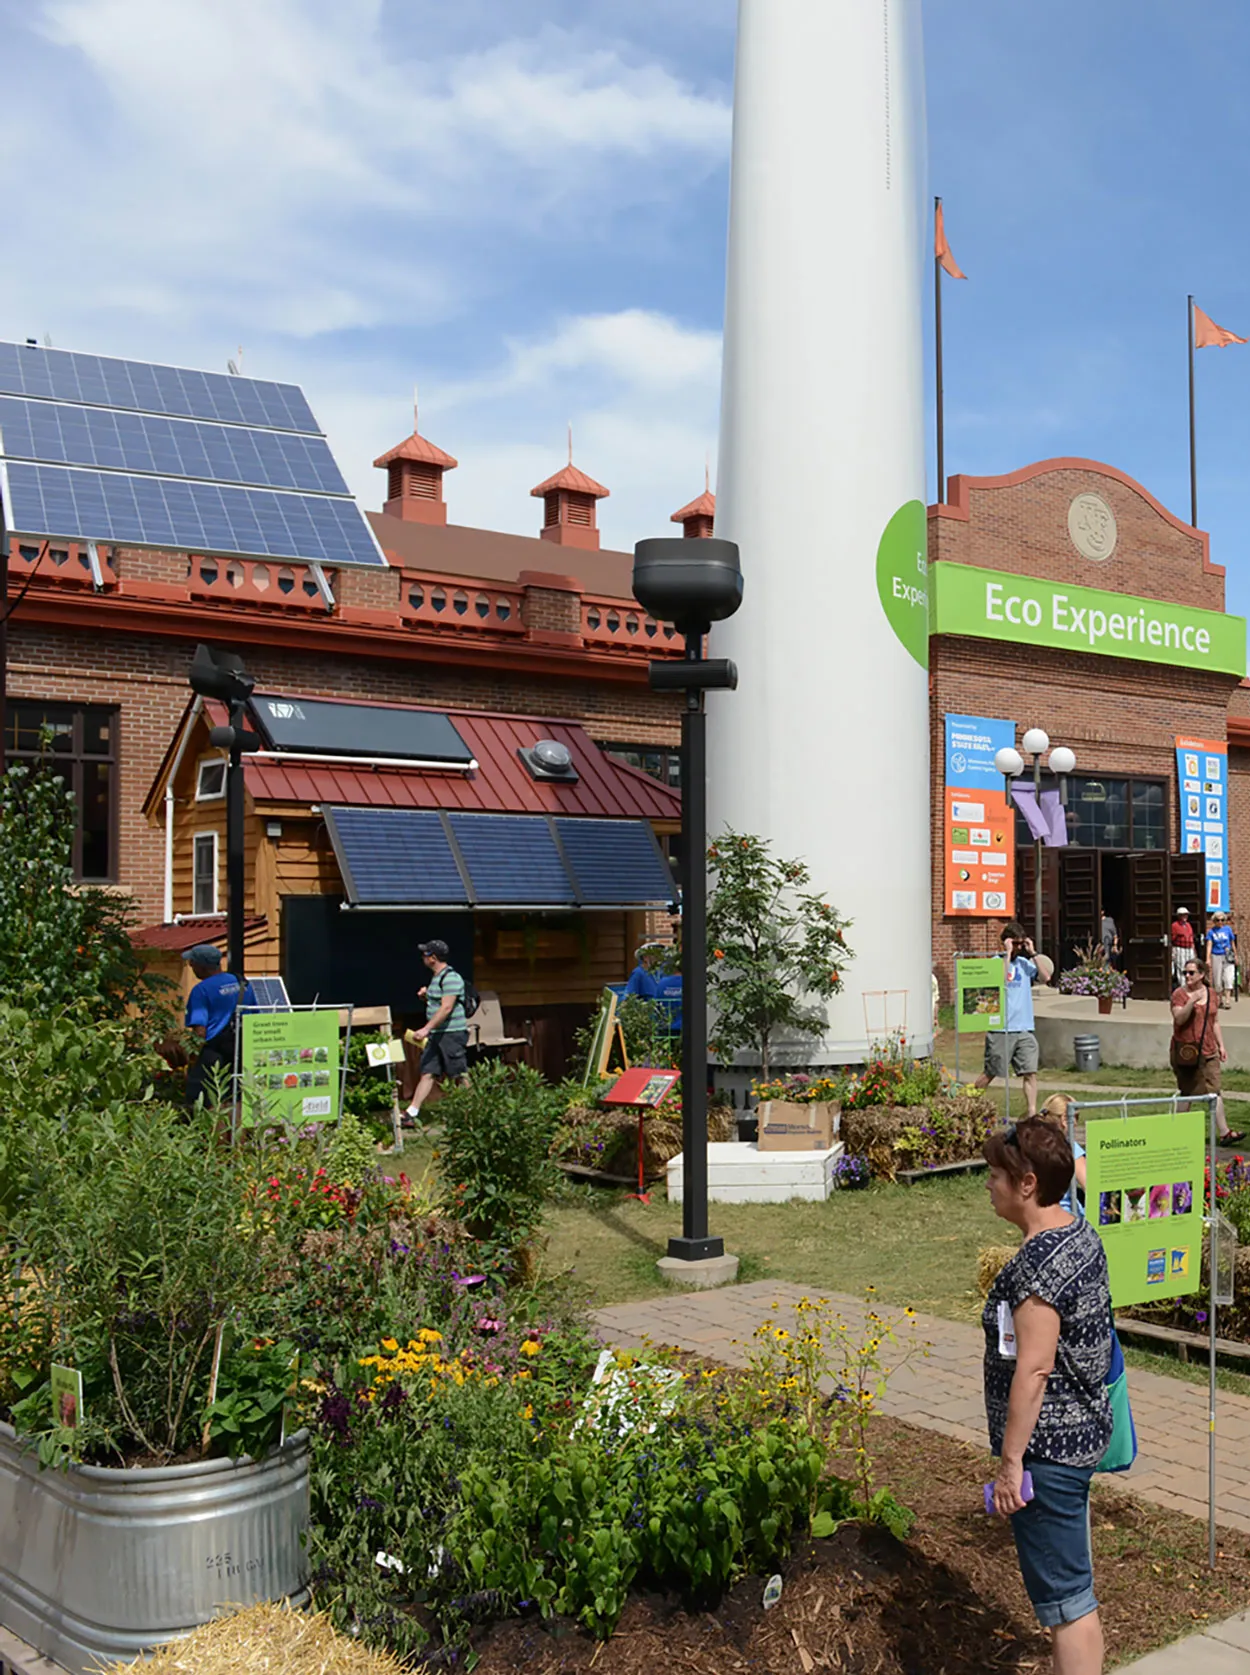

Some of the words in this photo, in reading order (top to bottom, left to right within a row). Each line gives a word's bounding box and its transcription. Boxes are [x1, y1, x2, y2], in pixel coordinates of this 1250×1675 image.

[985, 582, 1042, 628] Eco
[1052, 594, 1211, 654] Experience
[1100, 1138, 1147, 1150] Pollinators
